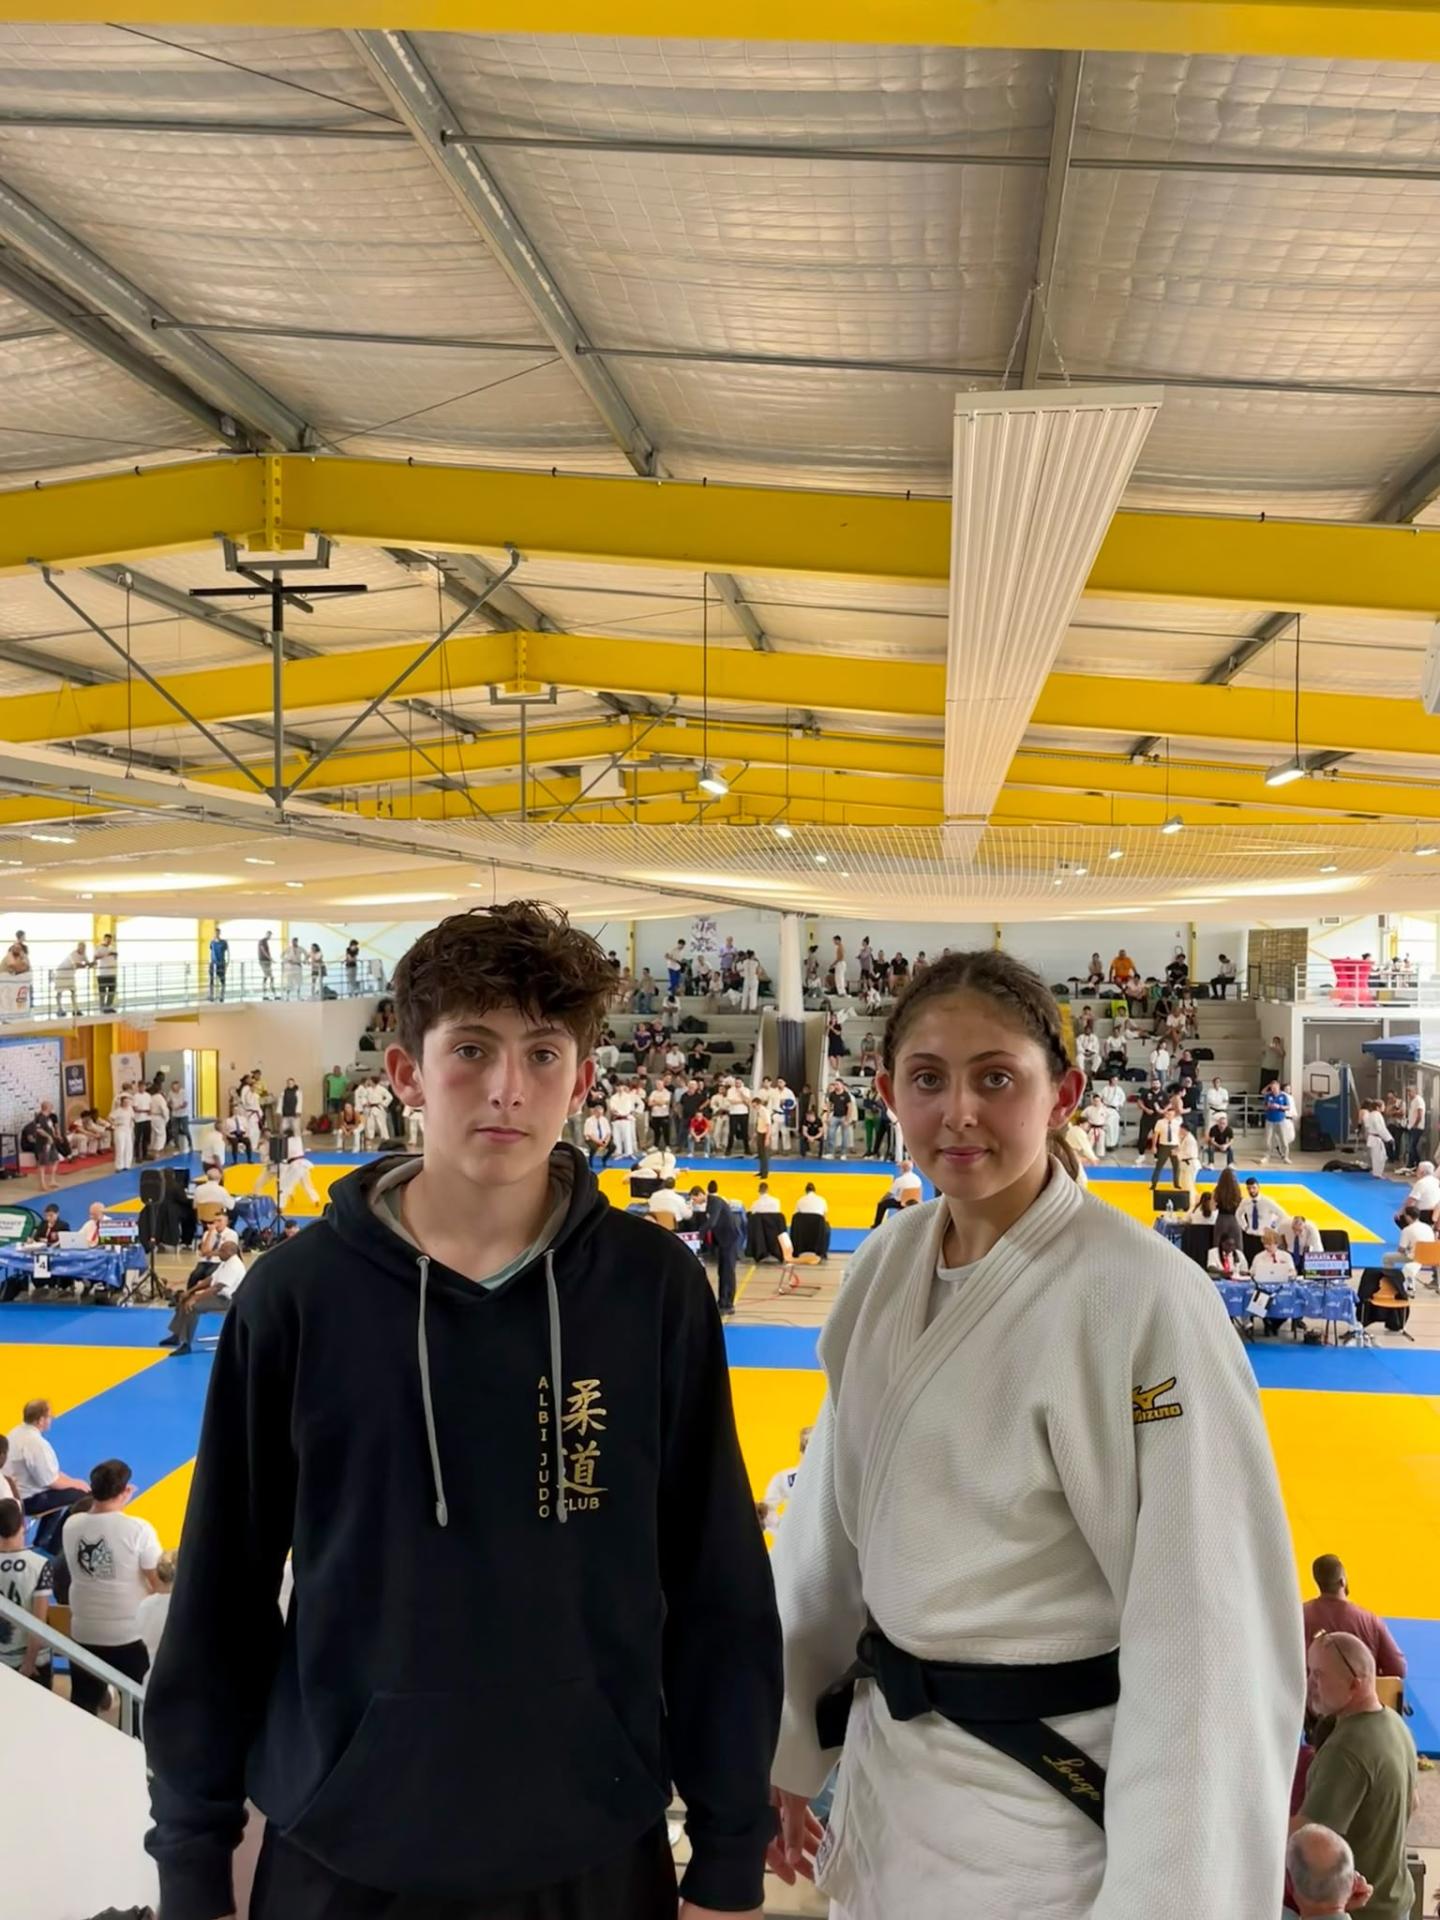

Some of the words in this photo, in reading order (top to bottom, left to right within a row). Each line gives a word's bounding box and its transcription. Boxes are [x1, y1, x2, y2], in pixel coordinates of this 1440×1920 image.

[538, 1375, 549, 1442] ALBI
[556, 1378, 608, 1495] 柔道
[538, 1453, 550, 1518] JUDO
